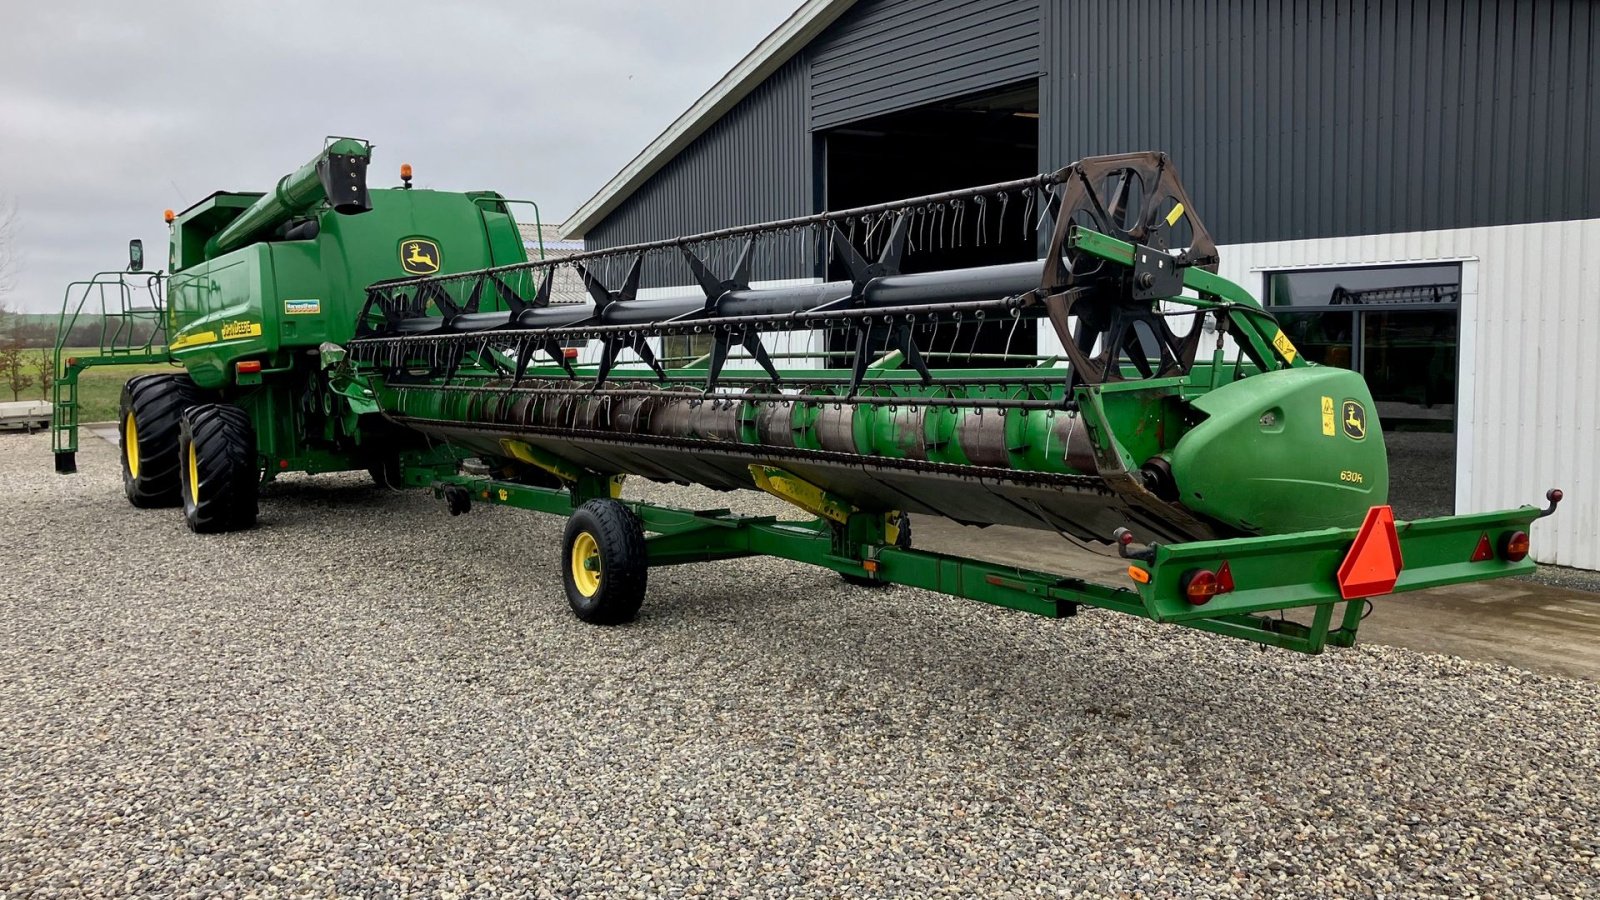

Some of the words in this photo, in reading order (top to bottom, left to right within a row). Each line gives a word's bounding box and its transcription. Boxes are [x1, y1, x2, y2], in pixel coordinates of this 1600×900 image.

[222, 320, 234, 337] JOHN
[234, 320, 252, 335] DEERE
[1340, 470, 1363, 483] 630R
